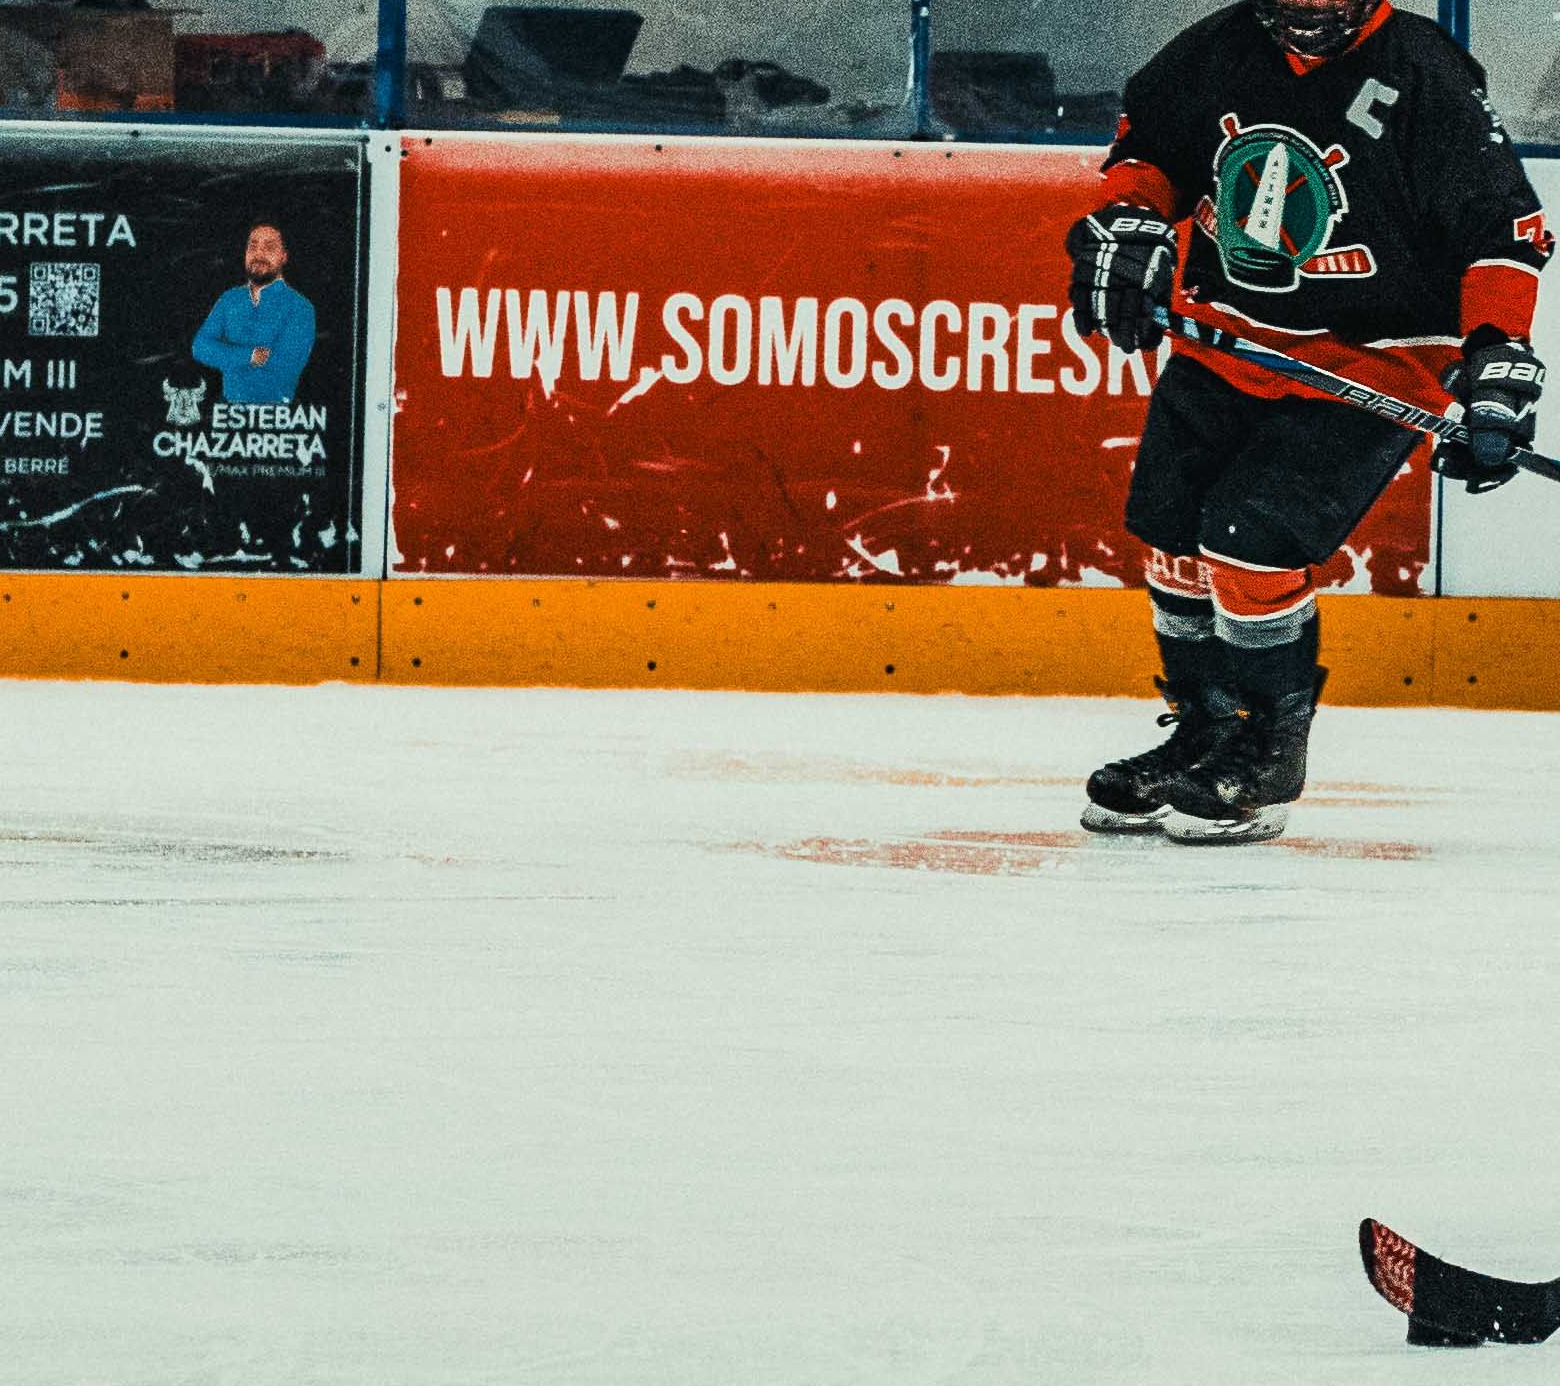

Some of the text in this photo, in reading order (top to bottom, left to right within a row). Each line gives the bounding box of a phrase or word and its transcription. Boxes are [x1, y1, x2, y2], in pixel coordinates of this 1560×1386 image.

[1346, 78, 1400, 139] C
[435, 287, 1172, 397] WWW.SOMOSCRESK
[46, 359, 77, 390] III
[212, 403, 327, 431] ESTEBAN
[153, 431, 327, 459] CHAZARRETA
